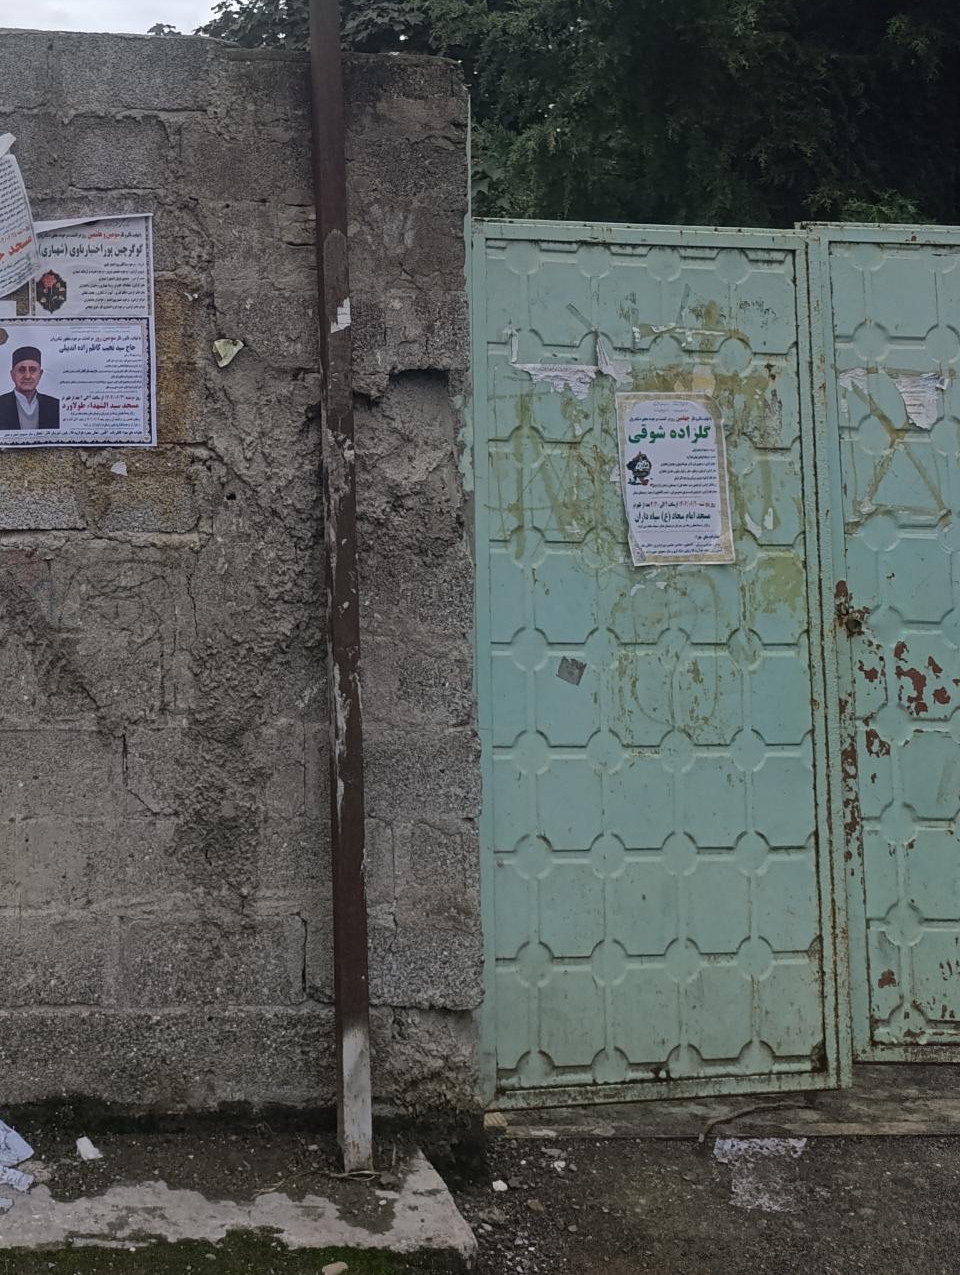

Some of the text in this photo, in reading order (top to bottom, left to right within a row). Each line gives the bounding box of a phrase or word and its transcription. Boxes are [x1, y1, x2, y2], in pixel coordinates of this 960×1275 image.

[8, 235, 33, 256] مسجد
[628, 424, 712, 444] گلزاده شوقی
[685, 512, 696, 521] امام
